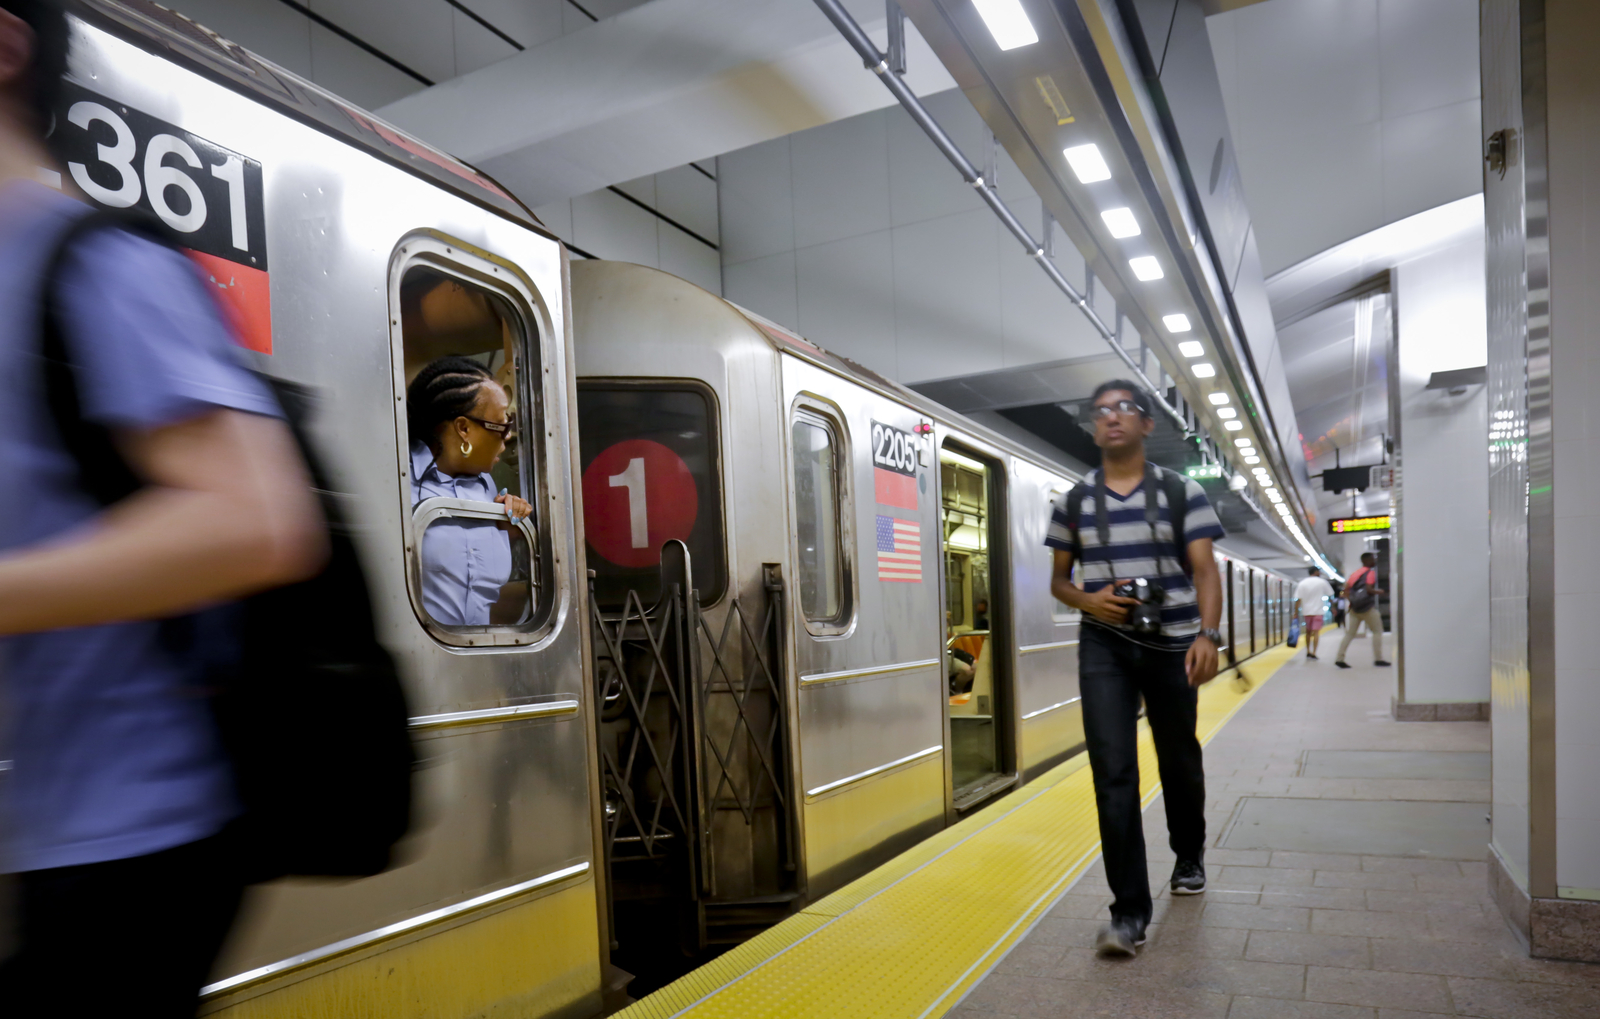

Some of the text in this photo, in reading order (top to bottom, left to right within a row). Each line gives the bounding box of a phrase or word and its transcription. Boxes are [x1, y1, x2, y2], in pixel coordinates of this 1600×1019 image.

[36, 101, 250, 252] 361
[873, 424, 916, 472] 2205
[608, 457, 649, 549] 1
